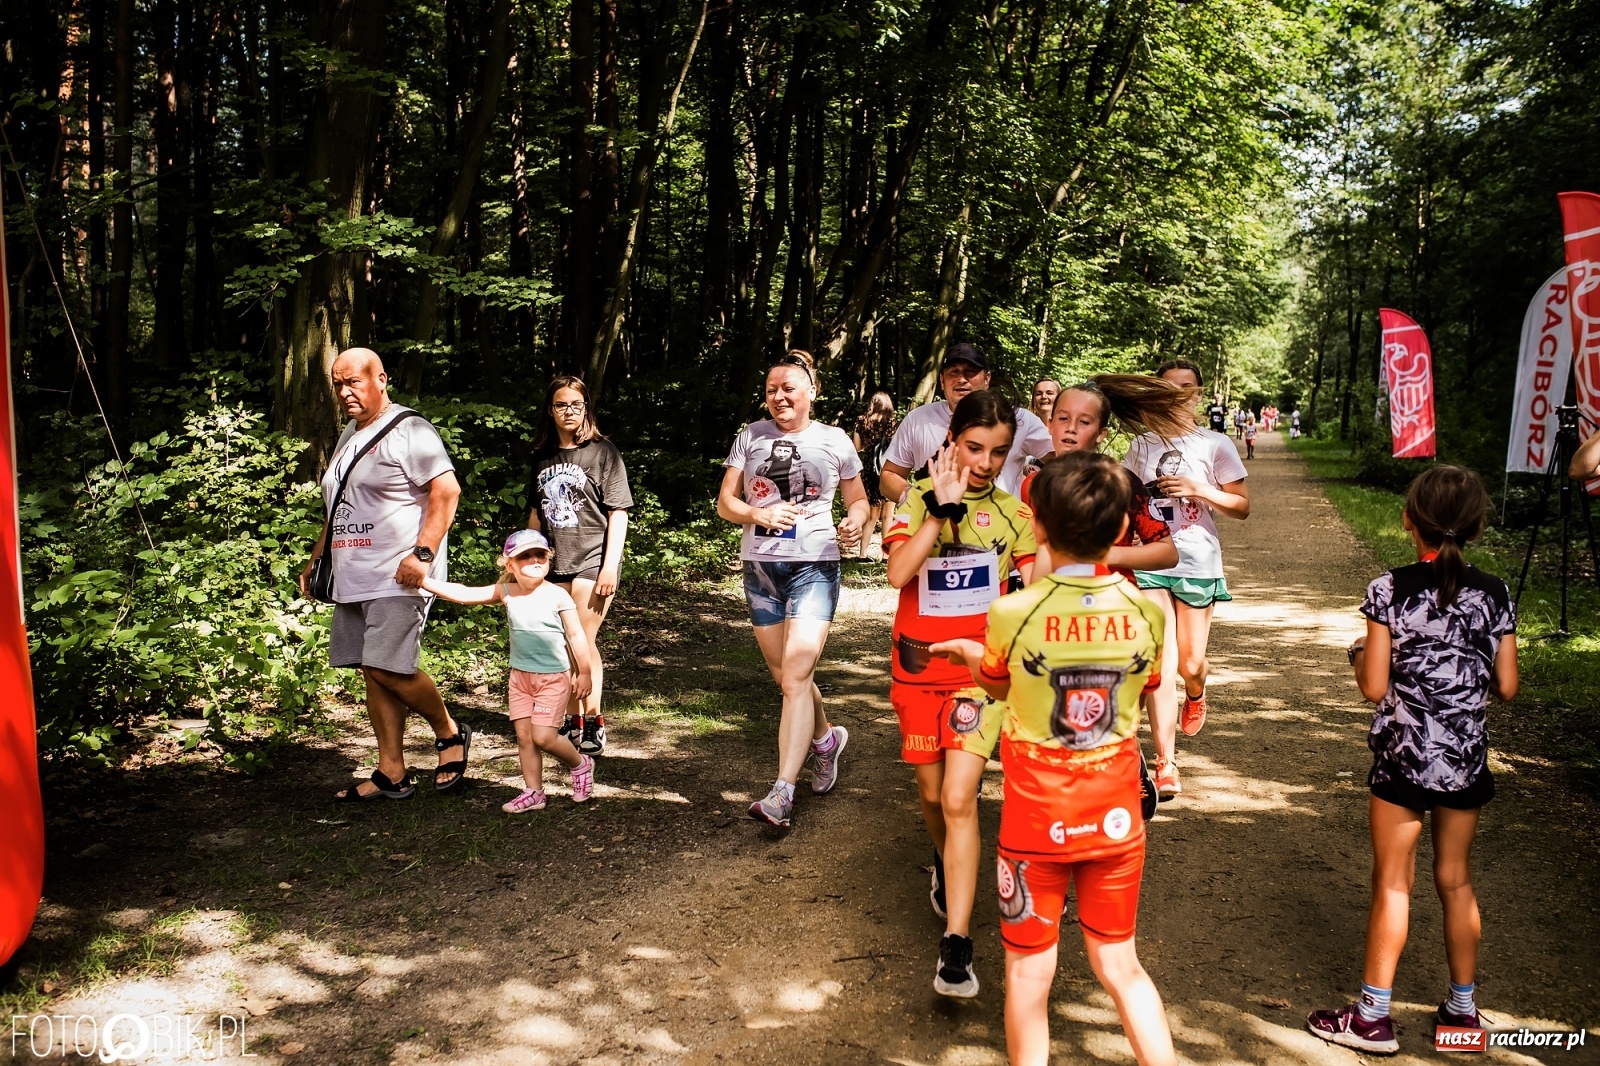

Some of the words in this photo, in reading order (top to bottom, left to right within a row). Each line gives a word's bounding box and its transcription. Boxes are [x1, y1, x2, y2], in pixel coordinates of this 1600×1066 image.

[1525, 283, 1568, 468] RACIBÓRZ
[333, 524, 347, 536] PER
[347, 523, 375, 535] CUP
[347, 538, 372, 548] 2020
[945, 569, 974, 589] 97
[1045, 615, 1137, 642] RAFAŁ
